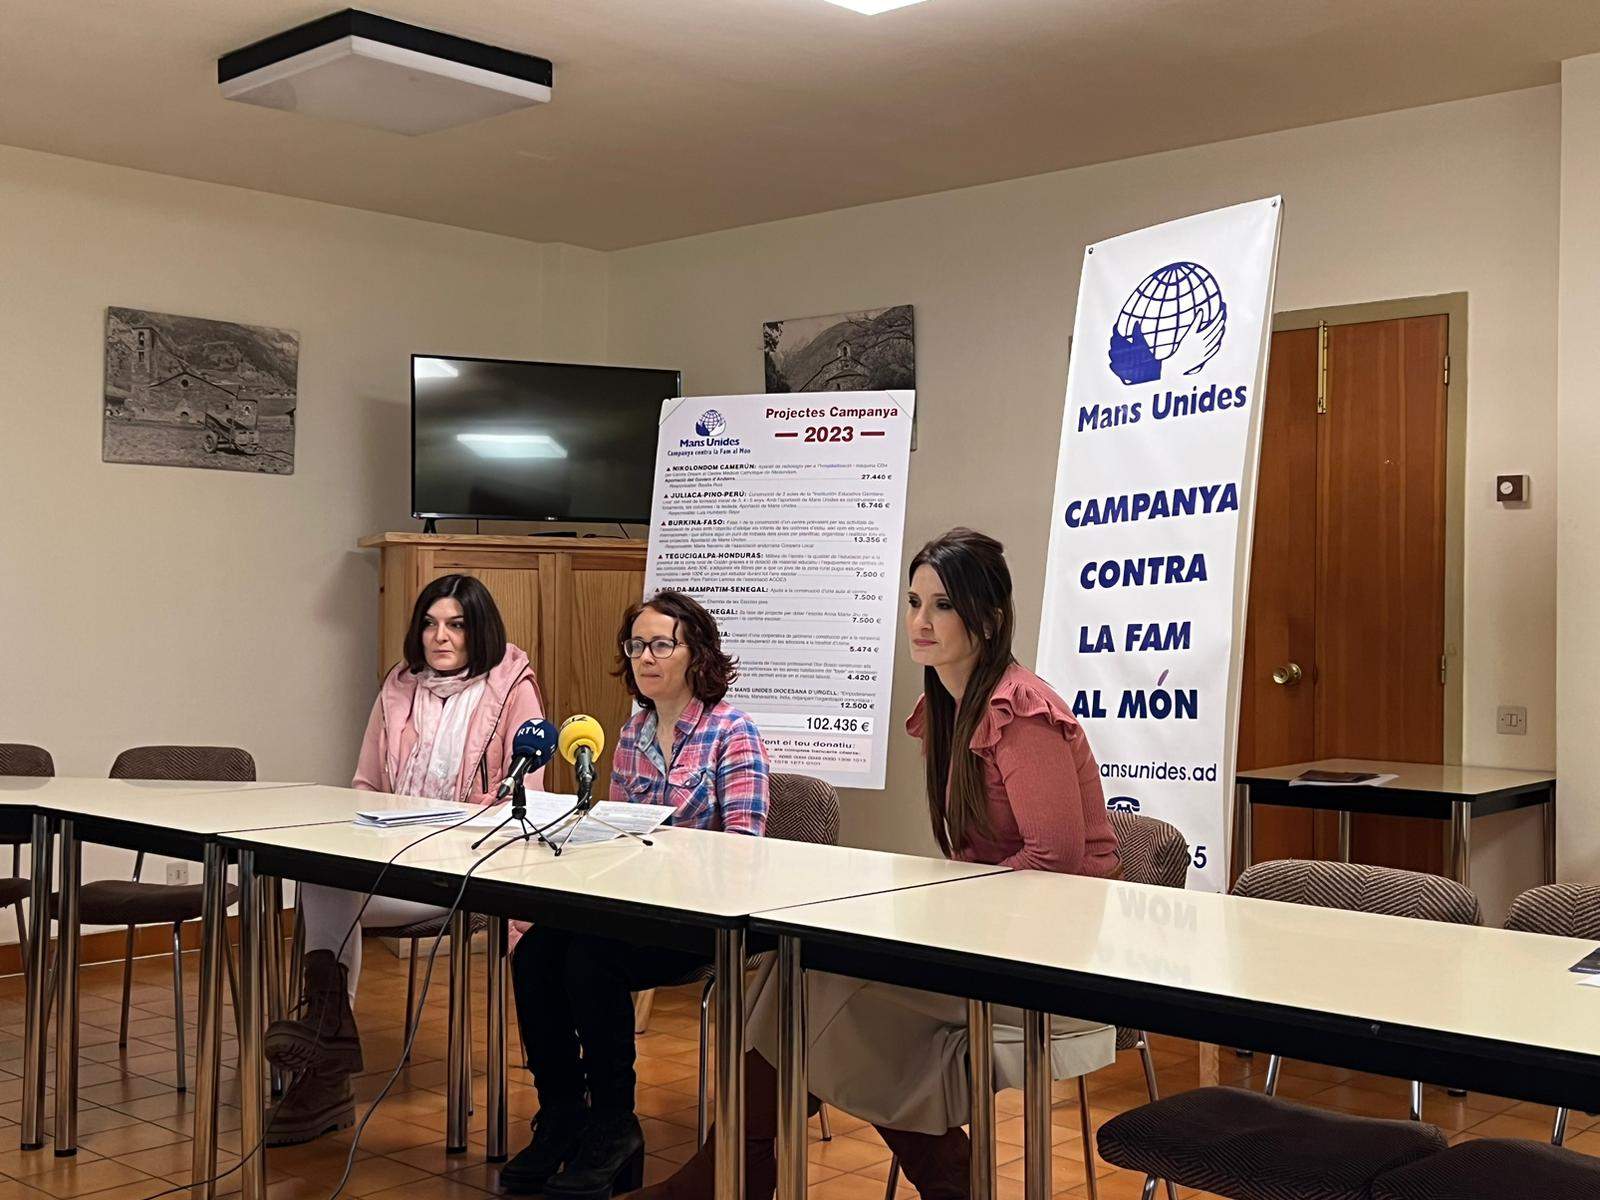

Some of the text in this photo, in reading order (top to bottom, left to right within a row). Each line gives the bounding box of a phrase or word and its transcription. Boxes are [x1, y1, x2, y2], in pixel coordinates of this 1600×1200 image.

[766, 406, 898, 420] Projectes Campanya
[1077, 384, 1247, 432] Mans Unides
[680, 438, 740, 448] Mans Unides
[804, 426, 854, 442] 2023
[1065, 482, 1239, 528] CAMPANYA
[1080, 553, 1208, 590] CONTRA
[1079, 621, 1192, 654] LA FAM
[1072, 669, 1198, 720] AL MÓN
[517, 726, 545, 739] RTVA
[806, 717, 870, 732] 102.436 €
[1100, 761, 1217, 782] ansunides.ad
